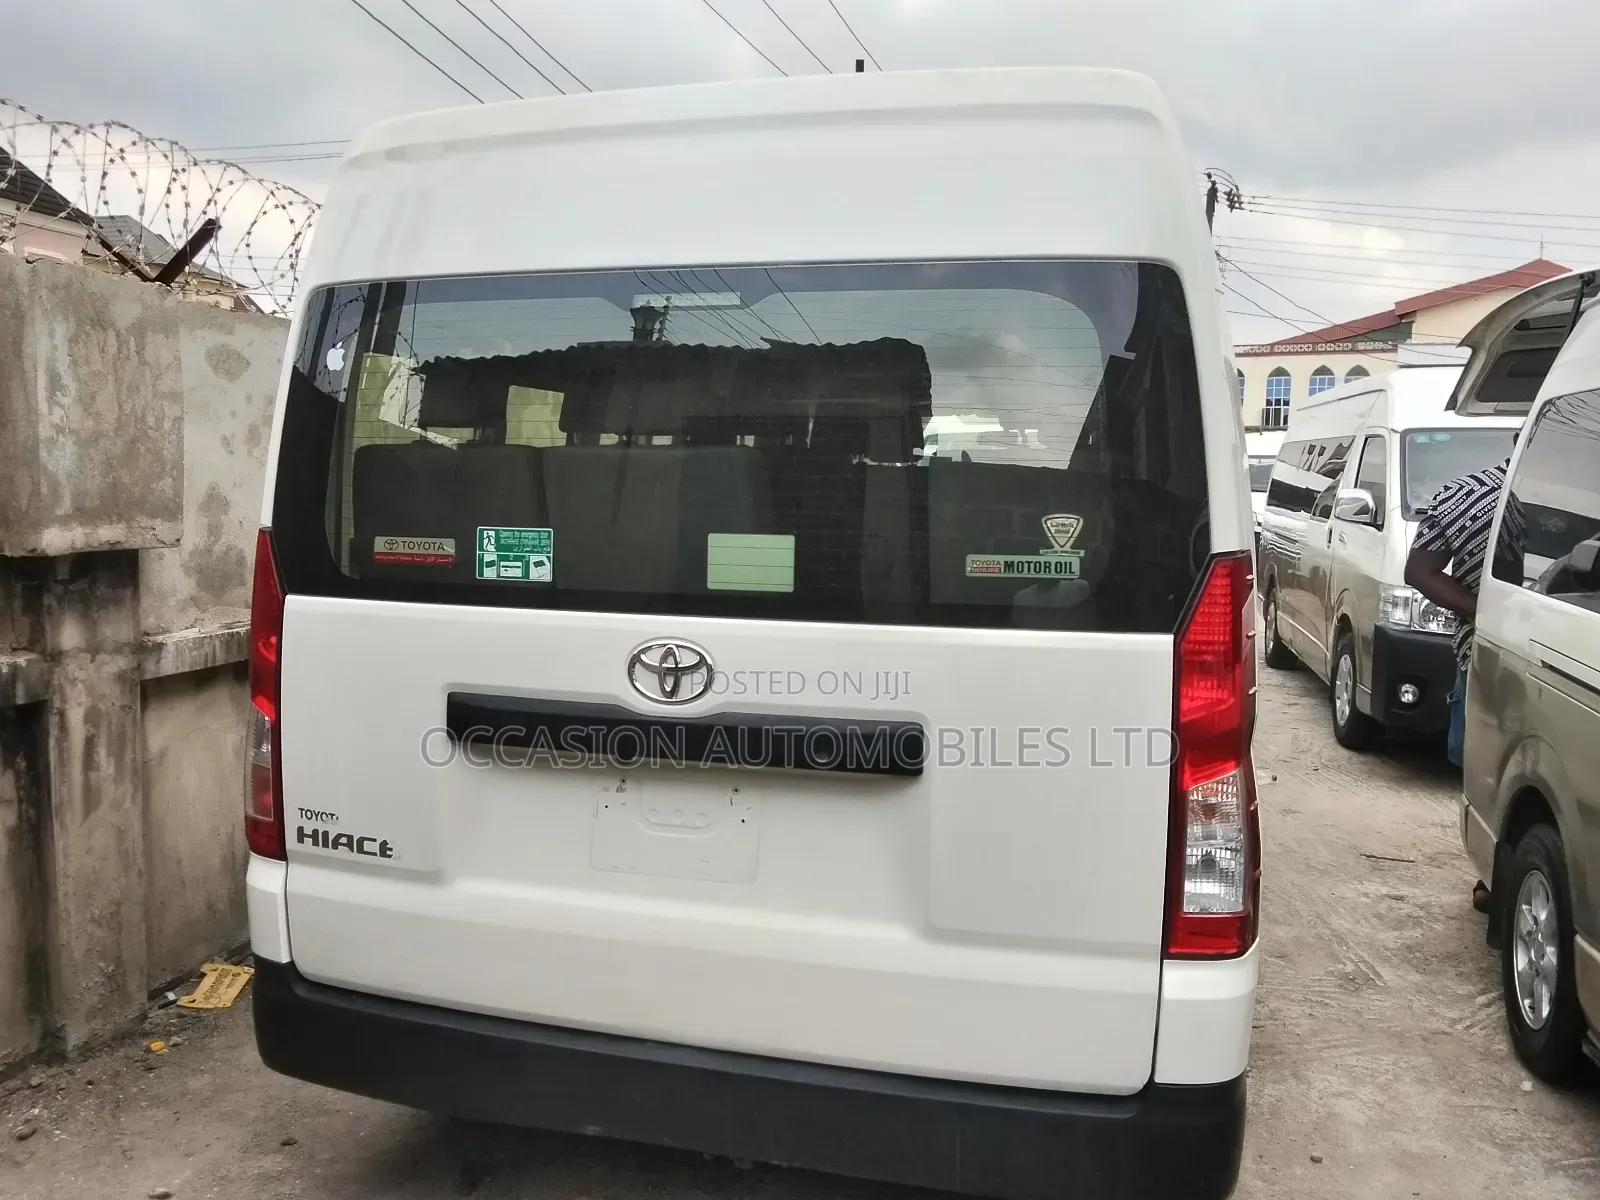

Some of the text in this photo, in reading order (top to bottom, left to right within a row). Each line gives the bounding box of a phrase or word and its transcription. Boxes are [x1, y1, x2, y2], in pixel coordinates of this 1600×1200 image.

[401, 540, 445, 551] TOYOTA
[1003, 561, 1076, 574] MOTOR OIL
[298, 807, 339, 821] TOYOT
